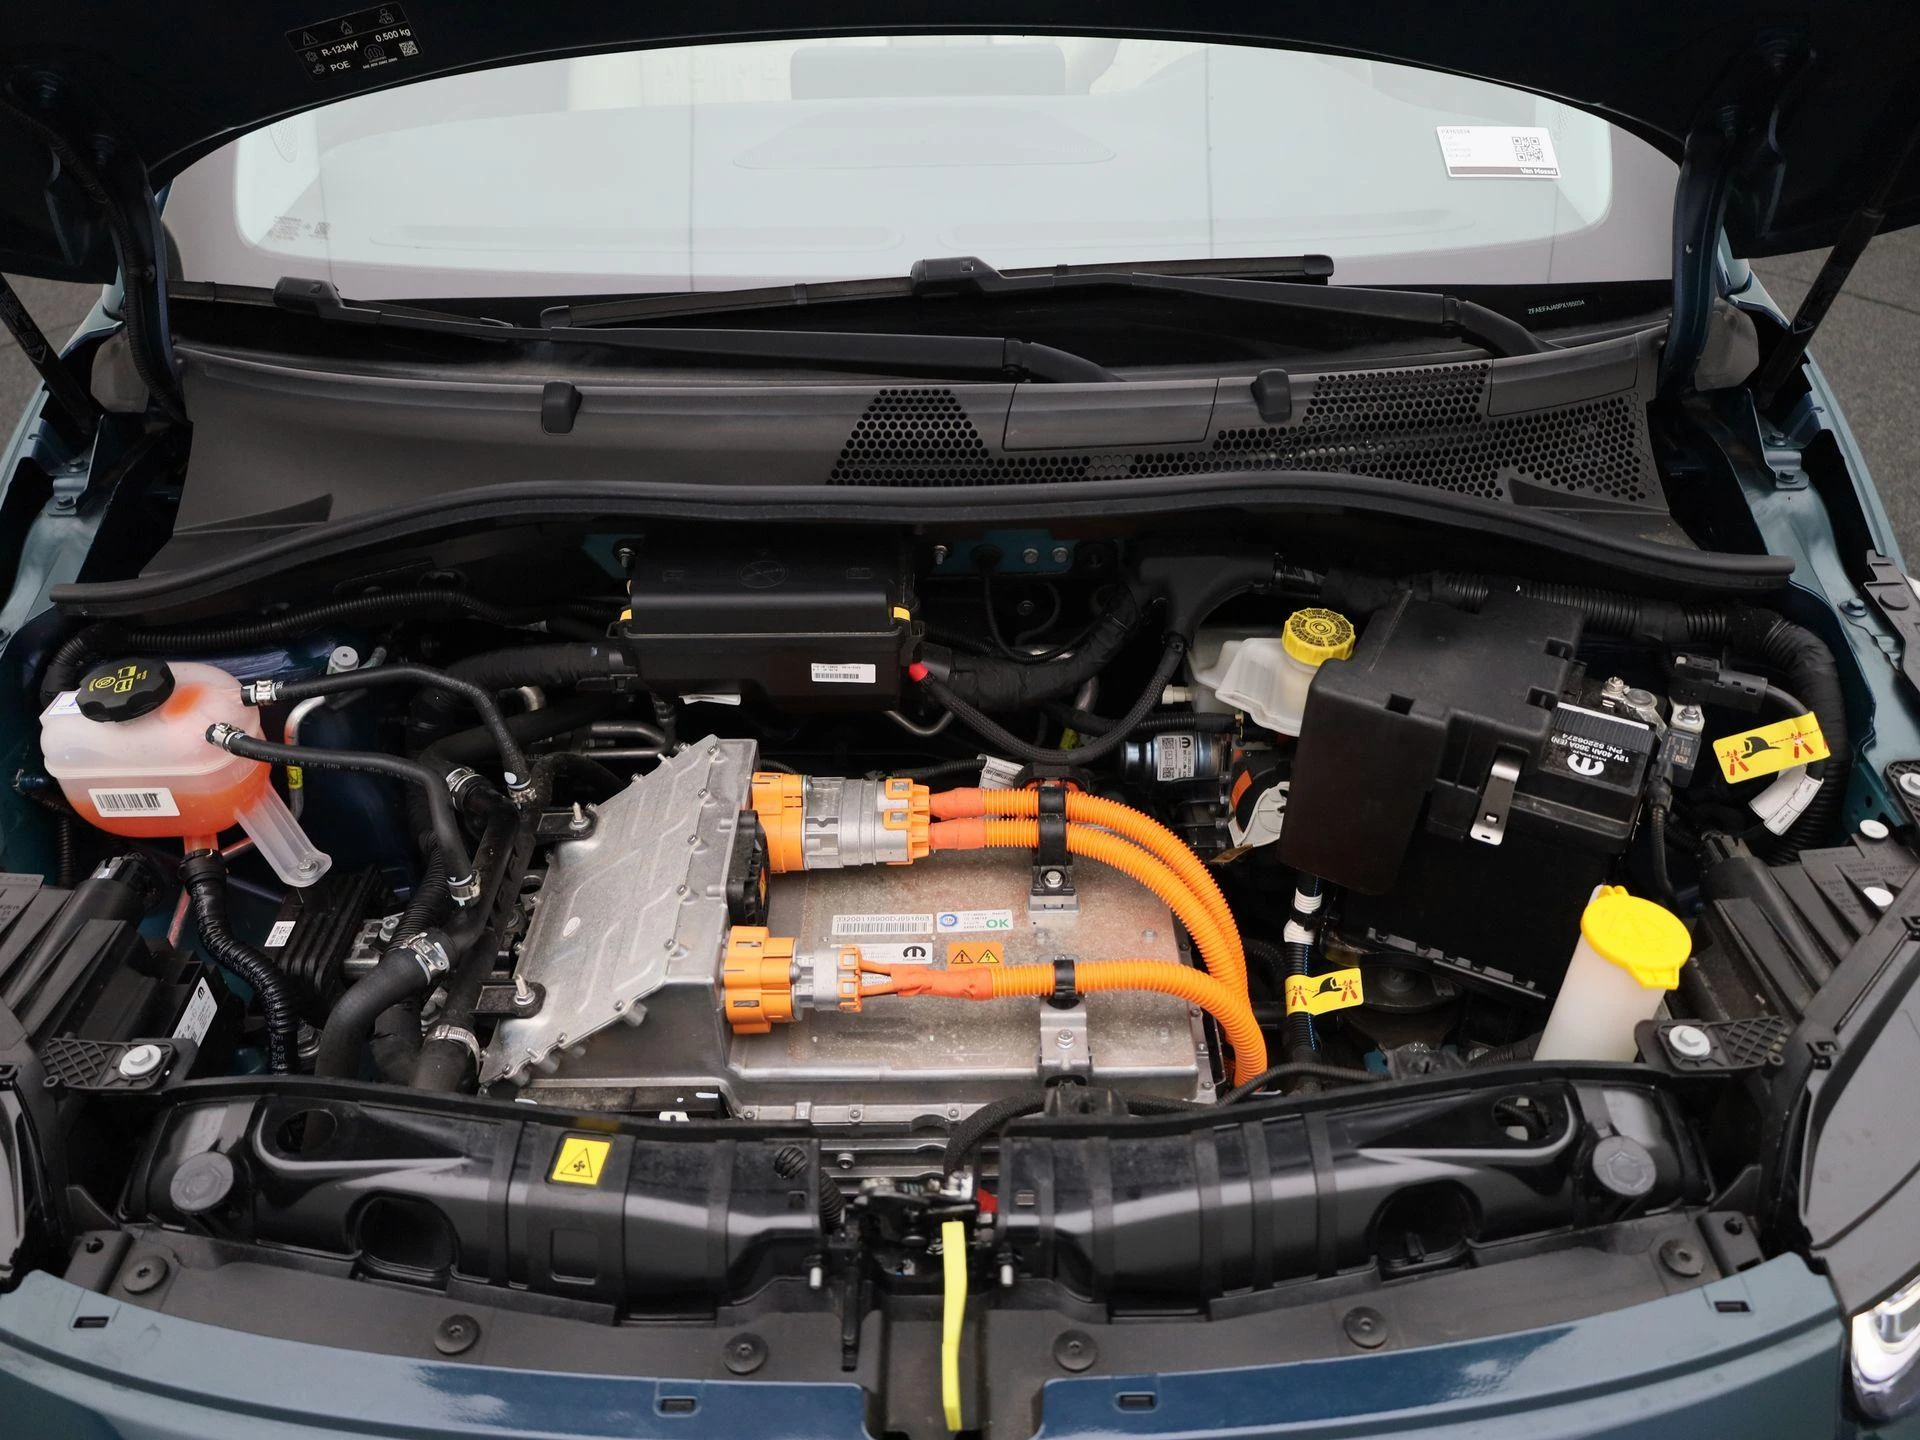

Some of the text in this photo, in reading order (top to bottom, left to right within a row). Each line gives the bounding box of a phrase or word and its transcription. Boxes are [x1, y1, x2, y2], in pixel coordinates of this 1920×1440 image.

[375, 28, 411, 42] 0.500 kg
[321, 41, 359, 57] R-1234yf
[330, 60, 351, 72] POE
[1551, 735, 1629, 763] 12V 40Ah 360A (EN)
[1606, 744, 1623, 755] PN:
[985, 918, 1009, 929] OK
